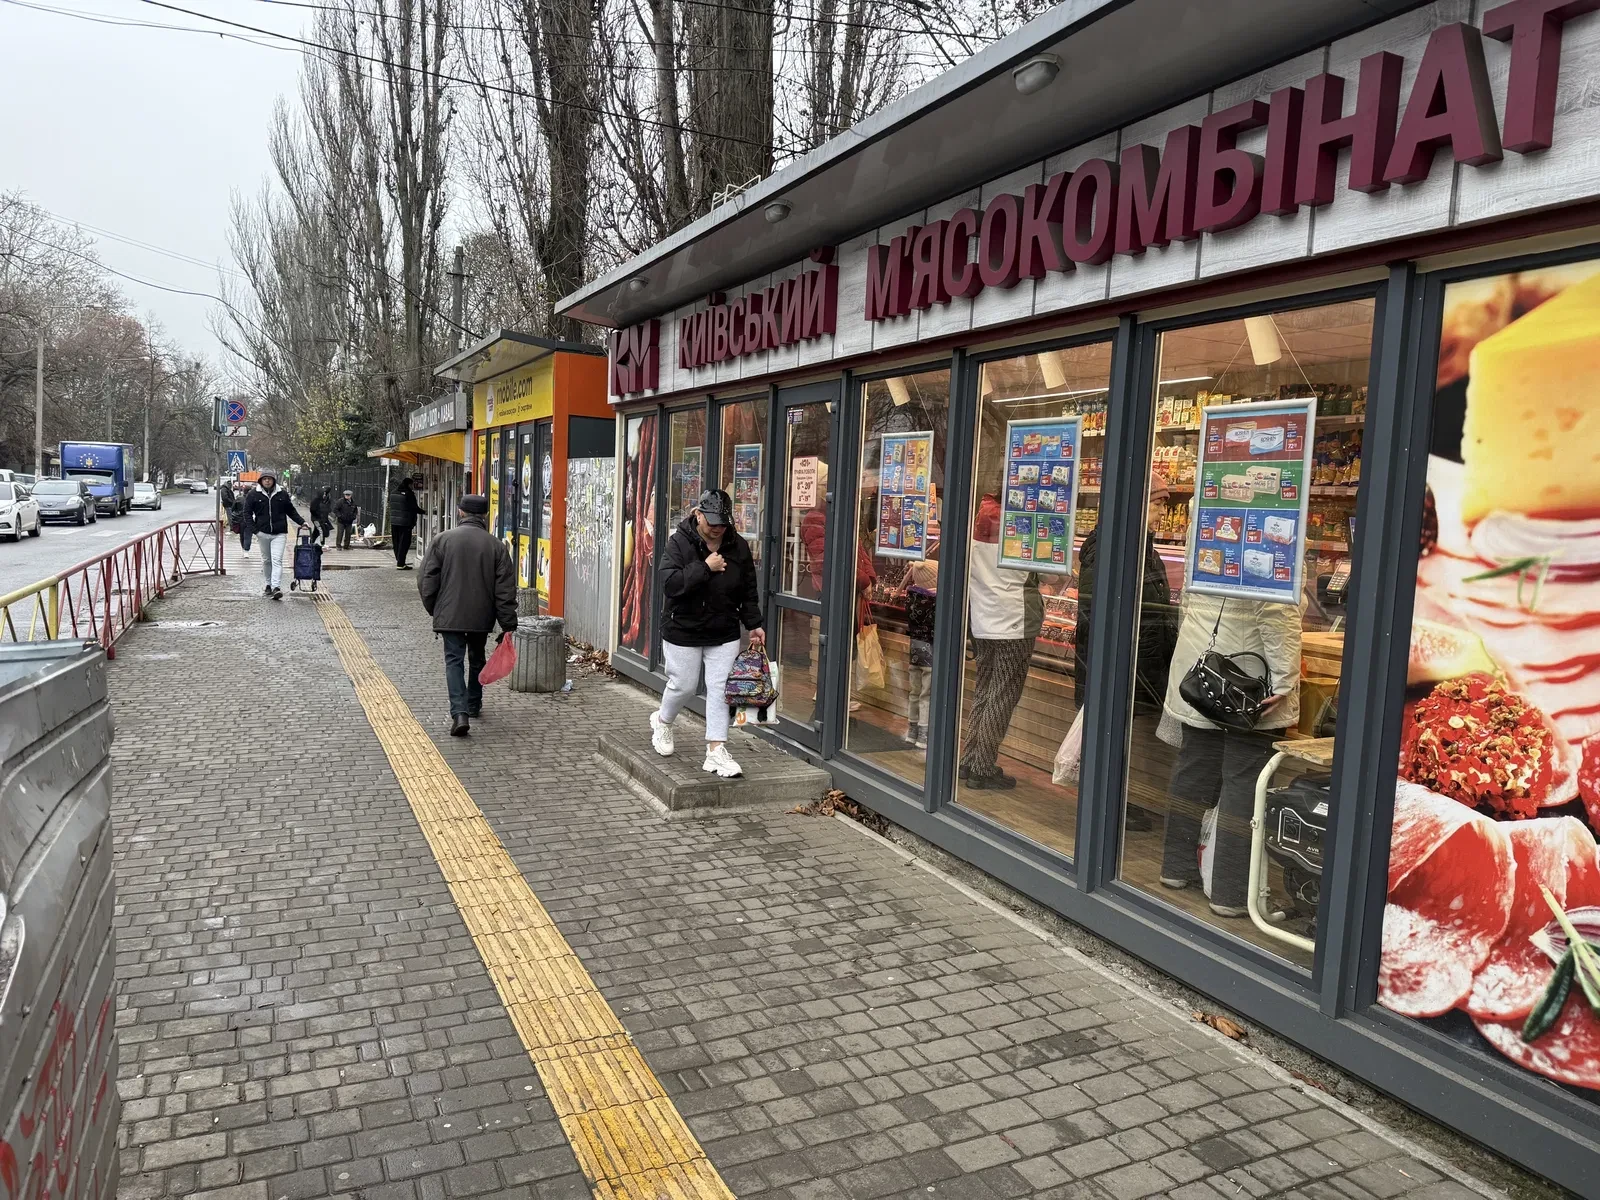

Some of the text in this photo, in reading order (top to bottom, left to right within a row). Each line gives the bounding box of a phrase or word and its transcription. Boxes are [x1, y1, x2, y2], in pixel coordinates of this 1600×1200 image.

[679, 0, 1600, 369] КИЇВСЬКИЙ М'ЯСОКОМБІНАТ
[497, 375, 533, 405] mobile.com
